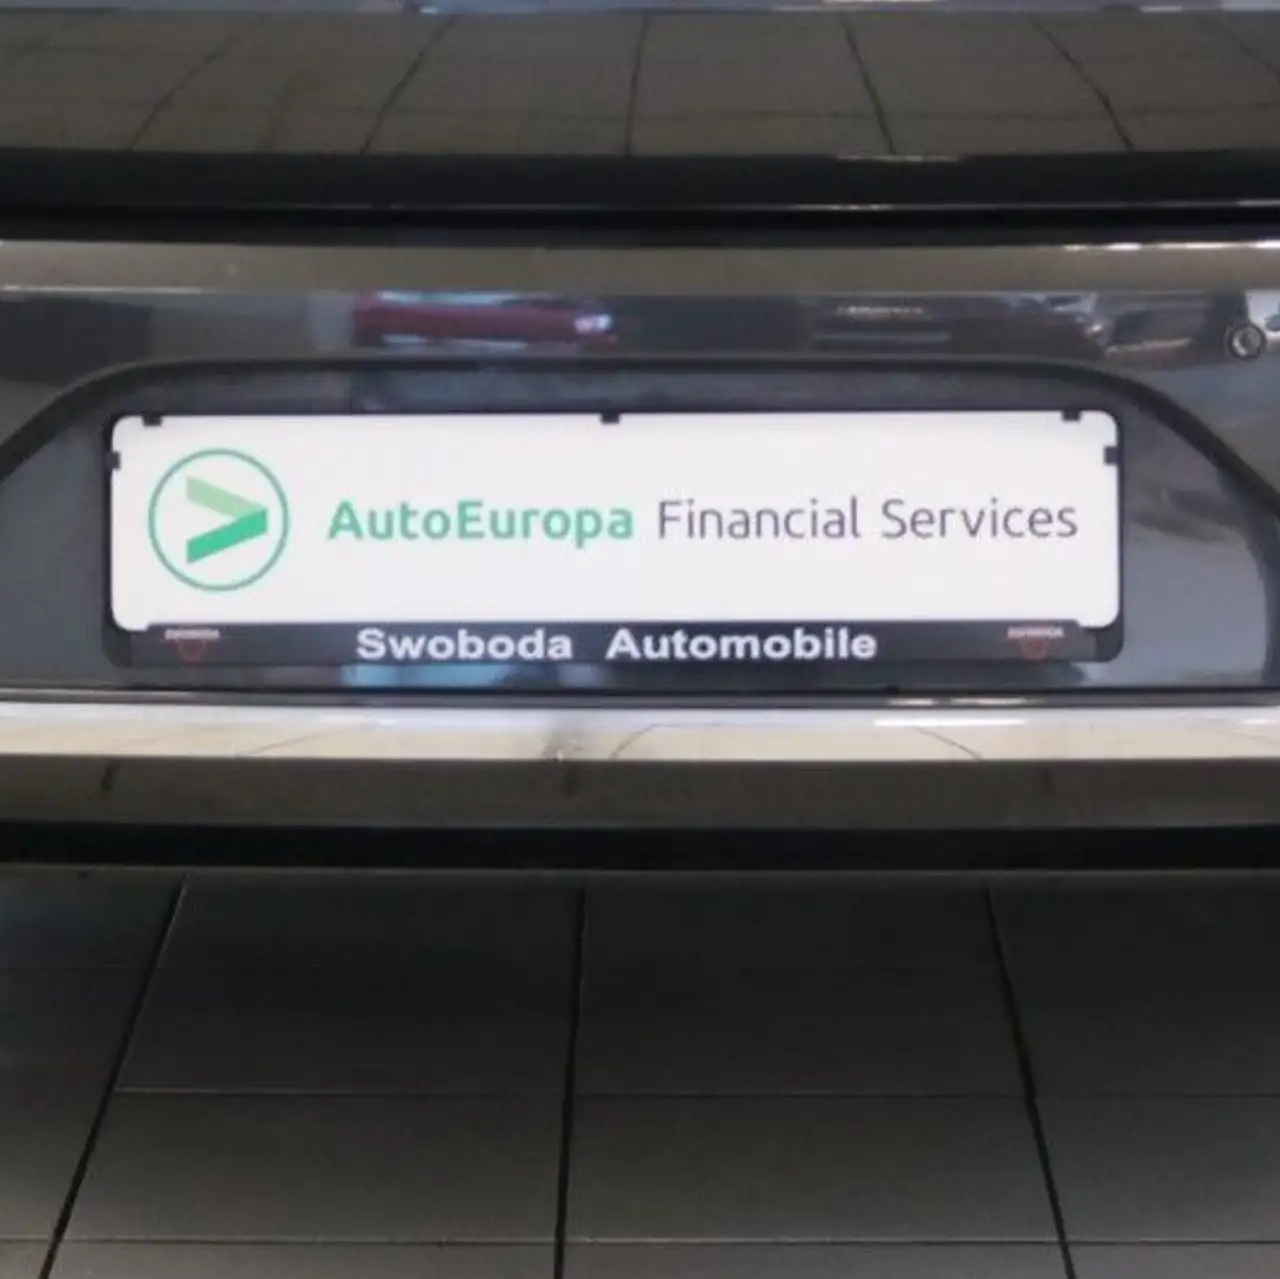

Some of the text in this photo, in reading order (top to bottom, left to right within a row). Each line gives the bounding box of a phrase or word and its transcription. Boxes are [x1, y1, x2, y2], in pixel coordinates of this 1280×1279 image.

[327, 496, 1079, 550] AutoEuropa Financial Services
[355, 627, 878, 660] Swoboda Automobile
